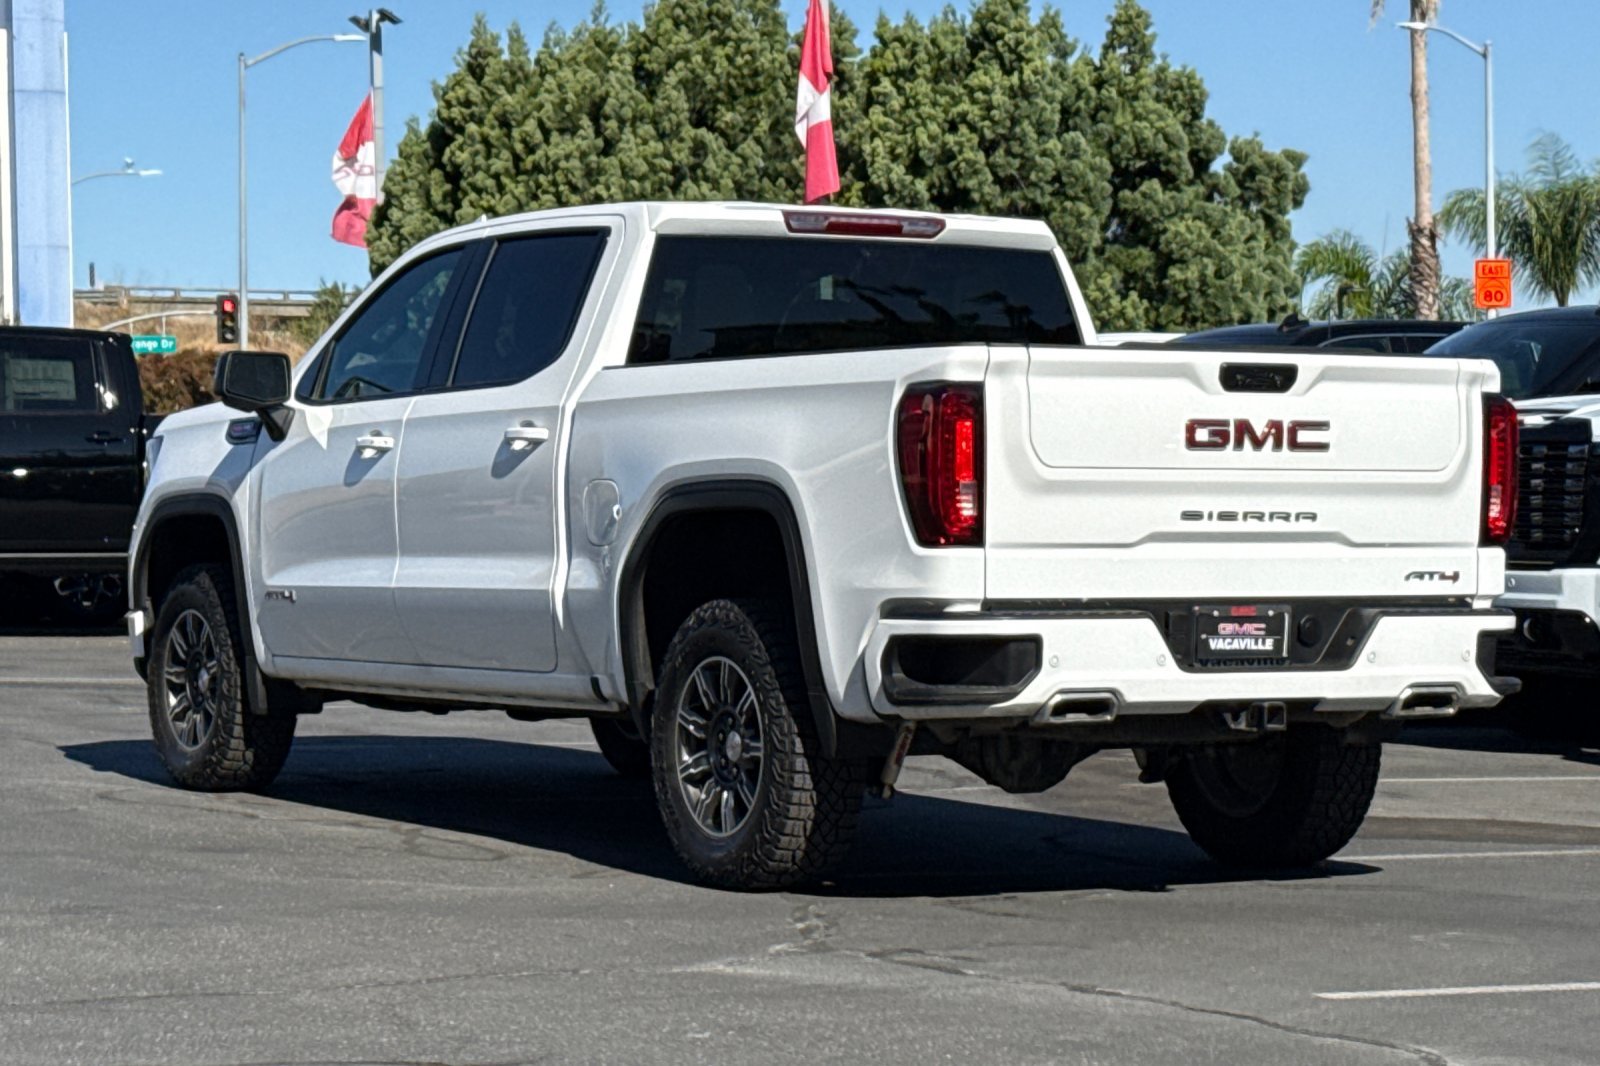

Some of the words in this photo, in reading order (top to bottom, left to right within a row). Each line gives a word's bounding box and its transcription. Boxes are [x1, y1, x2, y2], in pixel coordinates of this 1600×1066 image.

[1482, 264, 1505, 276] EAST
[1484, 289, 1504, 303] 80
[161, 339, 174, 348] Dr
[1184, 418, 1331, 453] GMC
[1180, 510, 1318, 523] SIERRA
[1404, 571, 1460, 584] AT4
[1217, 622, 1267, 635] GMC
[1208, 638, 1275, 650] VACAVILLE
